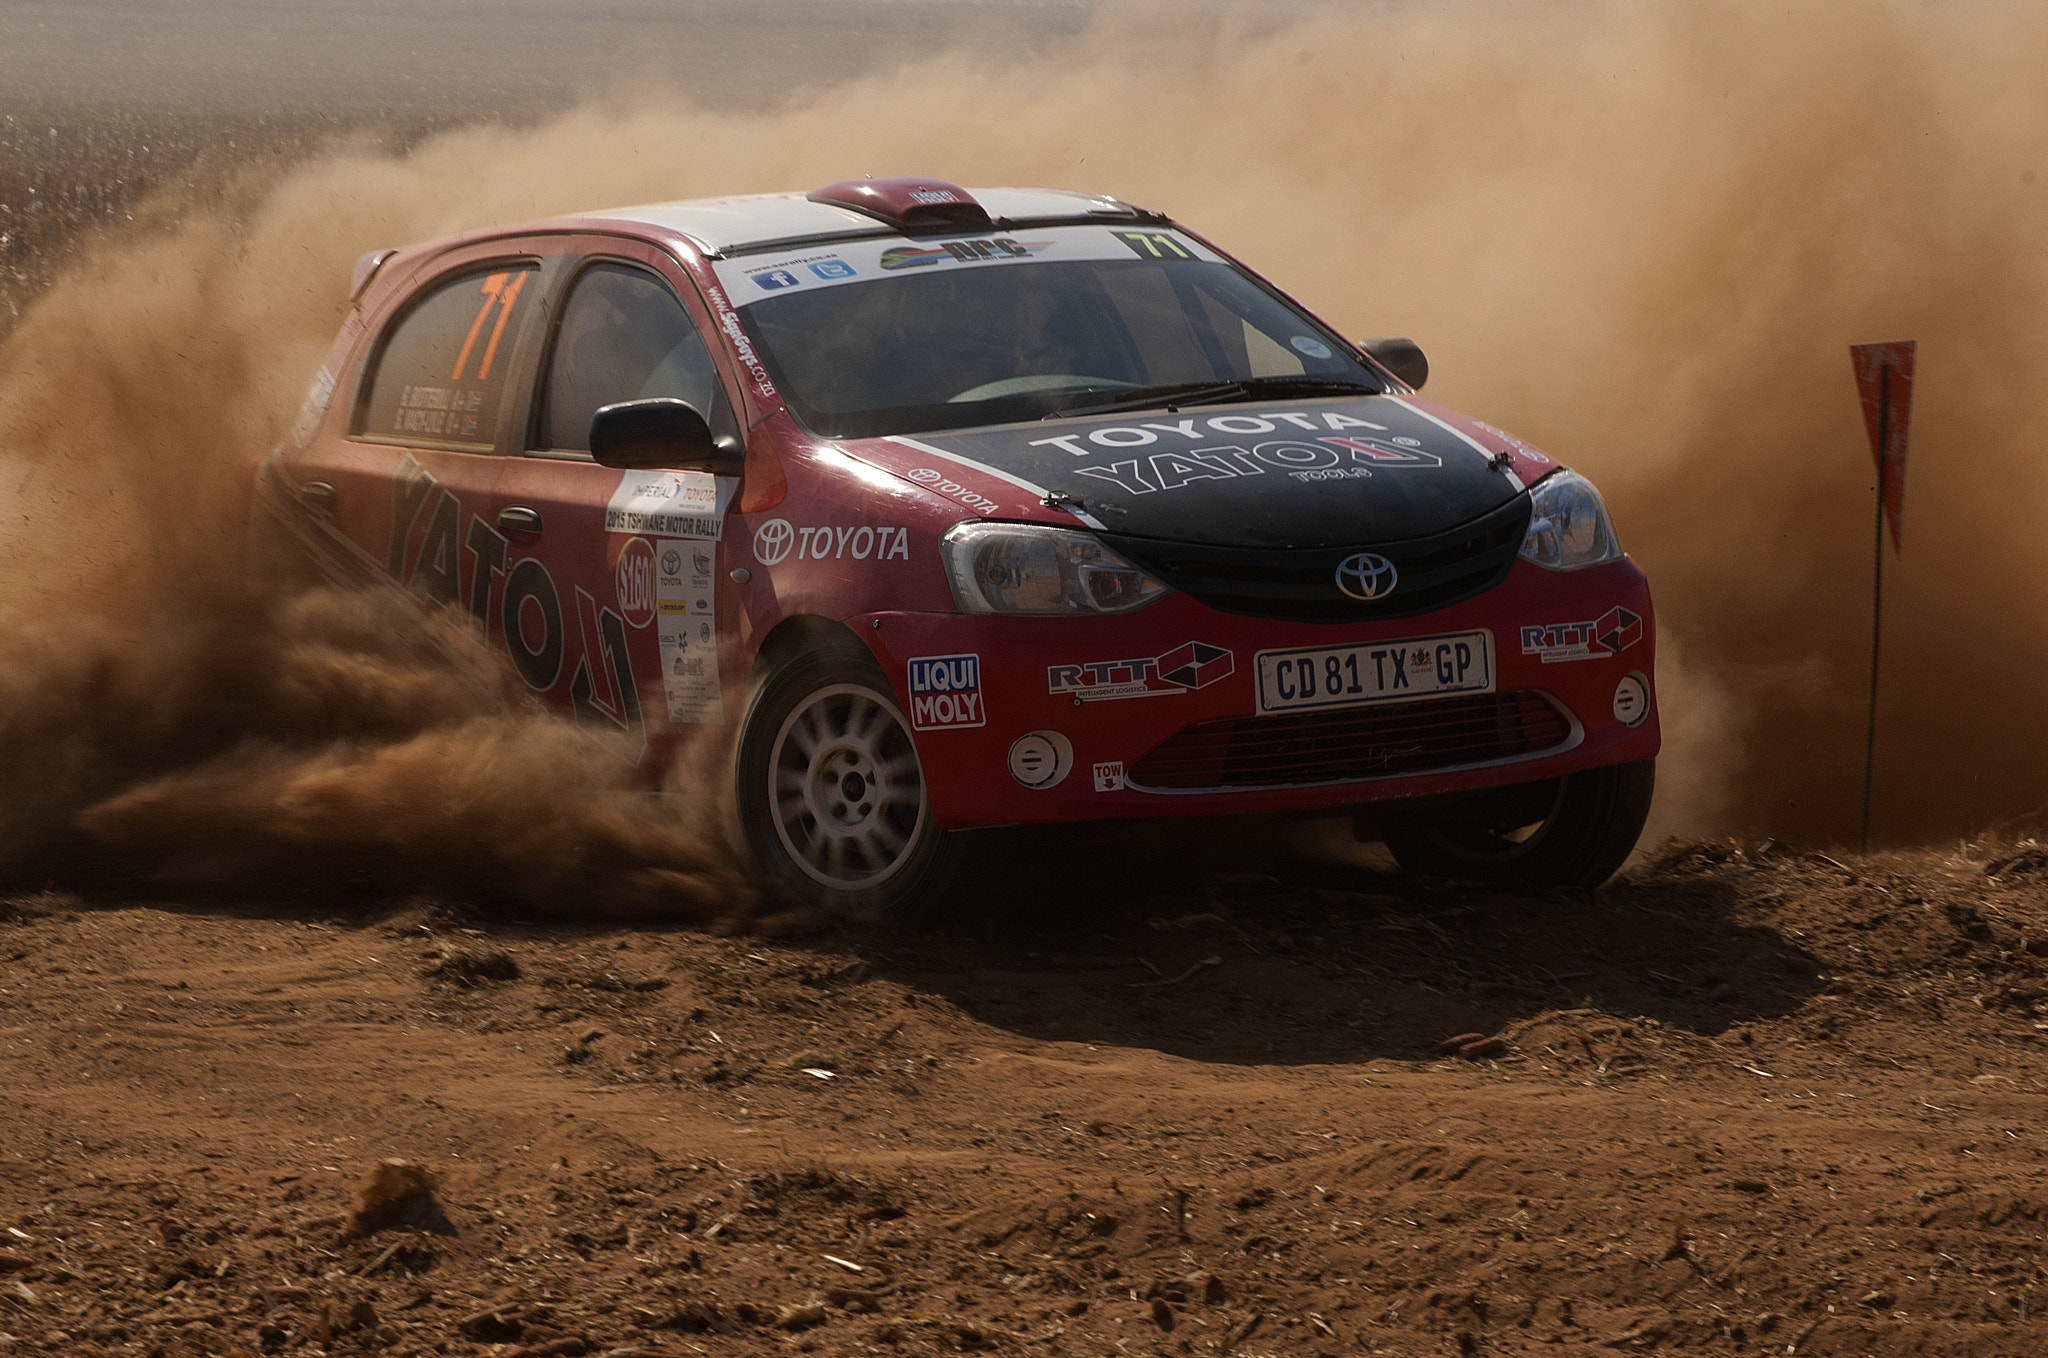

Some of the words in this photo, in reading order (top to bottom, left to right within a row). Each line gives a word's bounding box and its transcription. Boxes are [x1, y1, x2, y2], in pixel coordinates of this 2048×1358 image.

[1125, 233, 1190, 258] 71
[452, 269, 529, 380] 71
[1028, 413, 1388, 456] TOYOTA
[932, 478, 999, 515] TOYOTA
[607, 511, 626, 529] 2015
[627, 512, 665, 532] TSHWANE
[666, 515, 695, 535] MOTOR
[695, 517, 721, 538] RALLY
[798, 527, 909, 560] TOYOTA
[1521, 621, 1594, 648] RTT
[912, 659, 976, 693] LIQUI
[1050, 658, 1154, 689] RTT
[1277, 656, 1316, 700] CD
[1325, 652, 1363, 695] 81
[1371, 647, 1409, 692] TX
[1436, 642, 1471, 685] GP
[1078, 688, 1114, 697] INTELLIGENT
[1115, 686, 1147, 695] LOGISTICS
[914, 692, 978, 725] MOLY
[1094, 763, 1122, 779] TOW
